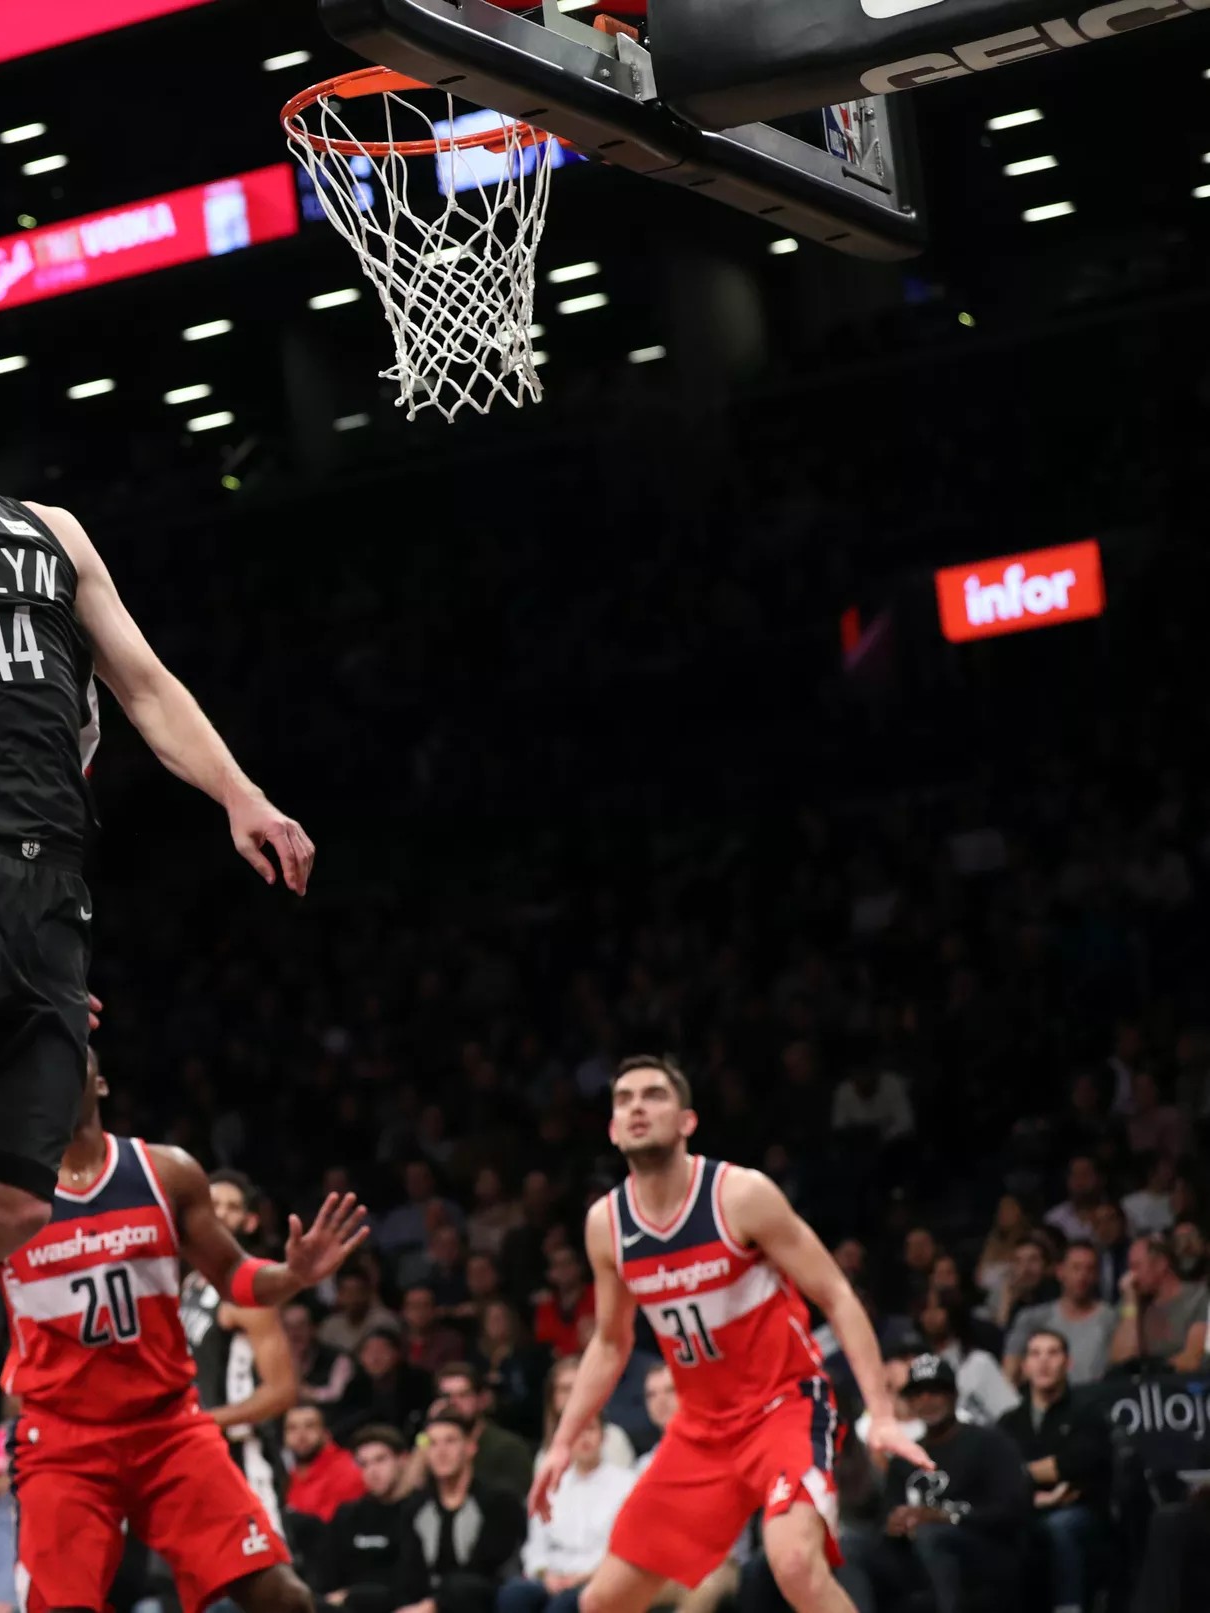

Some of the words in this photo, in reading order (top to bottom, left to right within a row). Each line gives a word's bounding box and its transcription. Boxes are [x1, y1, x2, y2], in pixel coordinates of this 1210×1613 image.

[860, 0, 1210, 95] GEIC
[963, 563, 1076, 626] infor
[27, 1225, 158, 1267] washington
[70, 1267, 139, 1346] 20
[661, 1303, 722, 1368] 31
